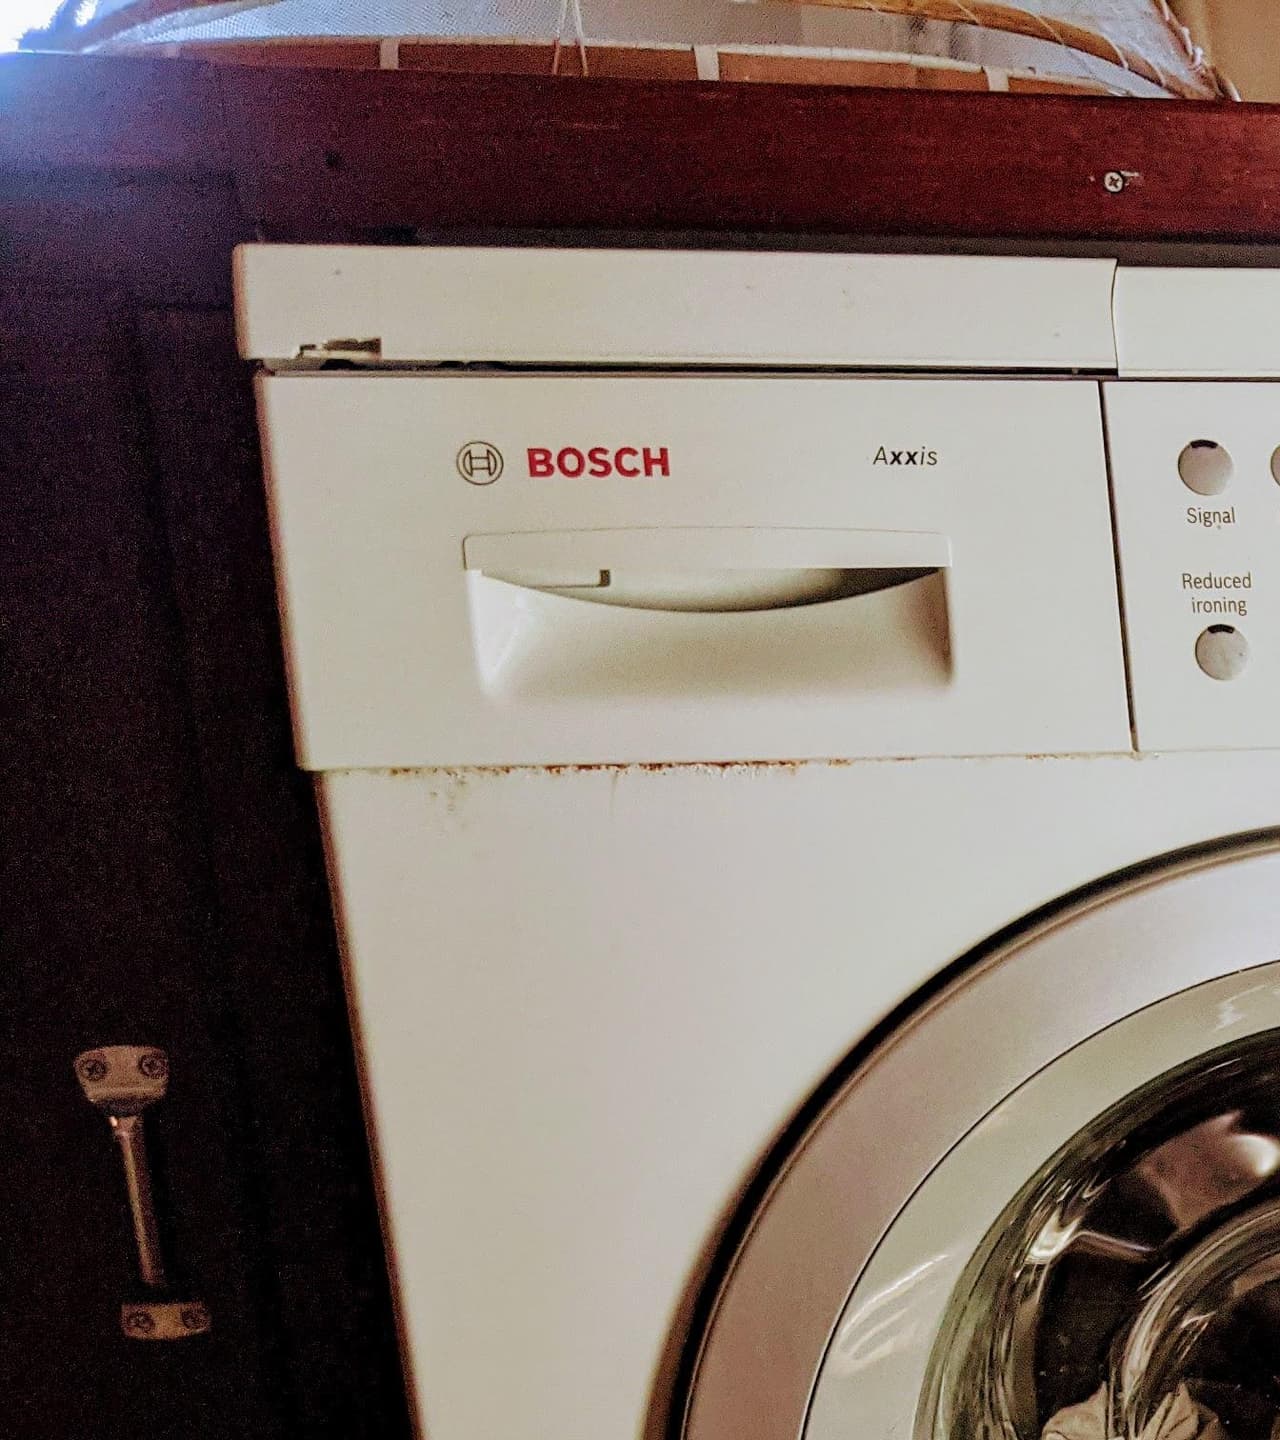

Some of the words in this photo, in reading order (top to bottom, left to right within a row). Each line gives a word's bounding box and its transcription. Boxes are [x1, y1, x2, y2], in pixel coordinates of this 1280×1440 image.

[527, 447, 670, 478] BOSCH
[873, 446, 937, 466] Axxis
[1187, 507, 1235, 527] Signal
[1182, 572, 1251, 589] Reduced
[1192, 597, 1247, 616] ironing
